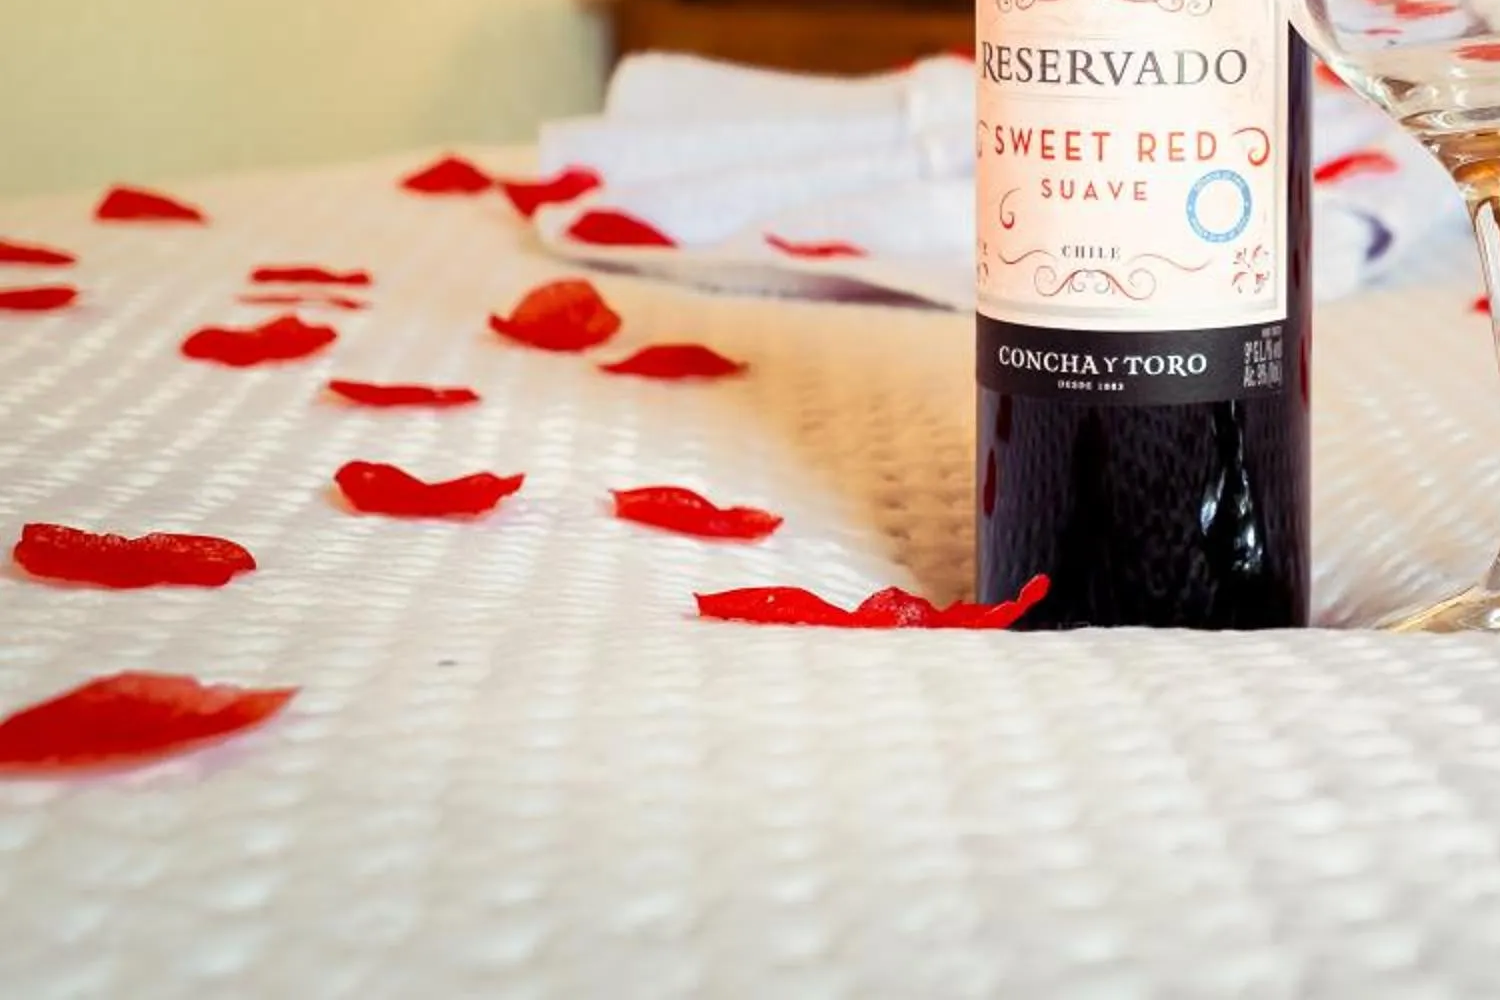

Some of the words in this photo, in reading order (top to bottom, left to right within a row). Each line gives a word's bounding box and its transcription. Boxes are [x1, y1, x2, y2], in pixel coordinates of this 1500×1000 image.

[982, 41, 1248, 86] RESERVADO
[994, 125, 1111, 162] SWEET
[1137, 131, 1217, 162] RED
[1041, 178, 1148, 201] SUAVE
[1061, 245, 1120, 259] CHILE
[999, 345, 1100, 375] CONCHA
[1103, 356, 1119, 373] Y
[1123, 353, 1207, 377] TORO
[1057, 380, 1092, 391] DESDE
